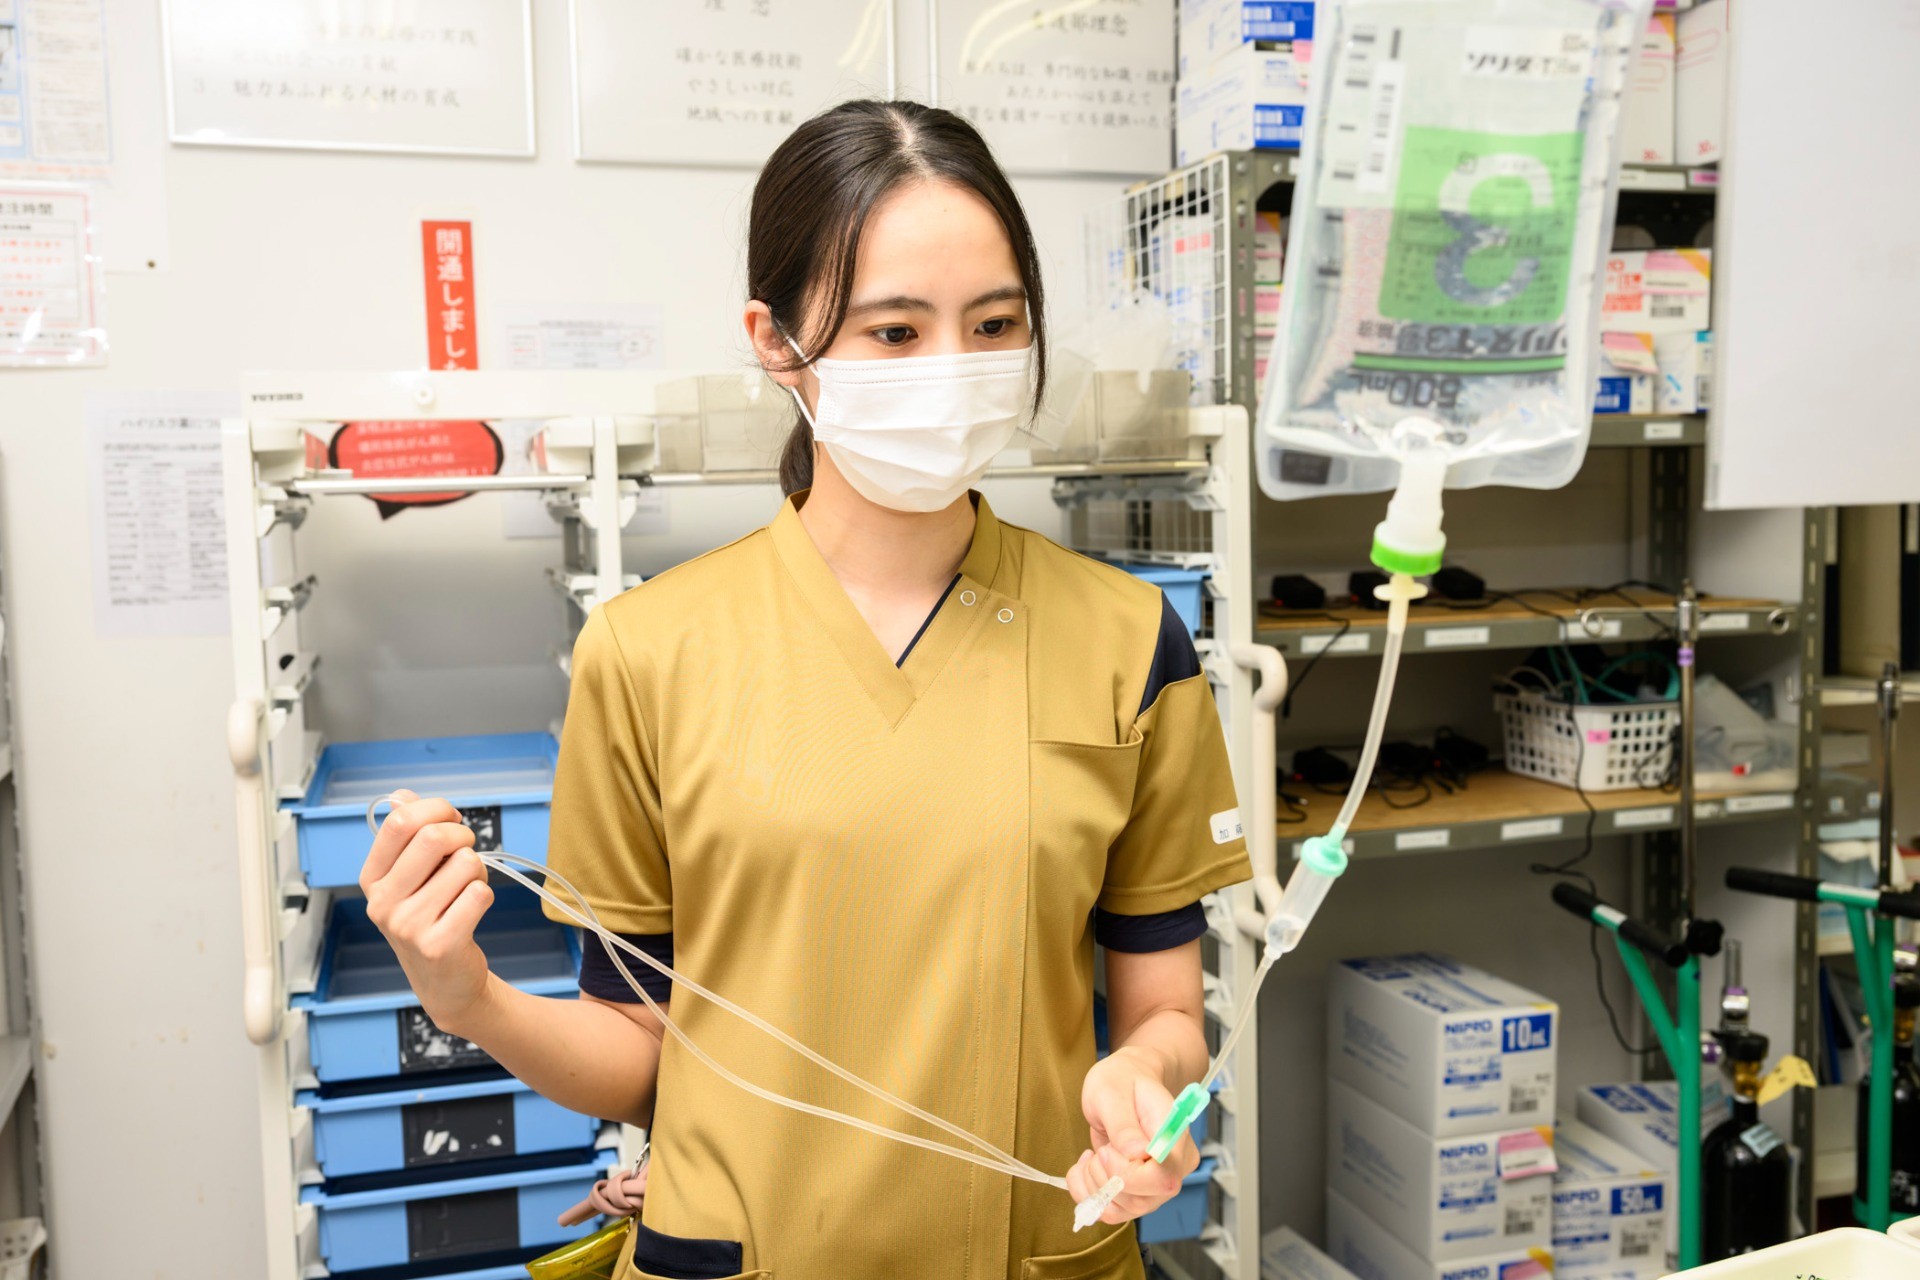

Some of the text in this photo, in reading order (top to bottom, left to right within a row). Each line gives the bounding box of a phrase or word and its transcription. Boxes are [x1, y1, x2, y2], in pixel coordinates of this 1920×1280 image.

[1348, 374, 1461, 408] 500mL
[1444, 1019, 1493, 1035] NIPRO
[1440, 1143, 1488, 1159] NIPRO
